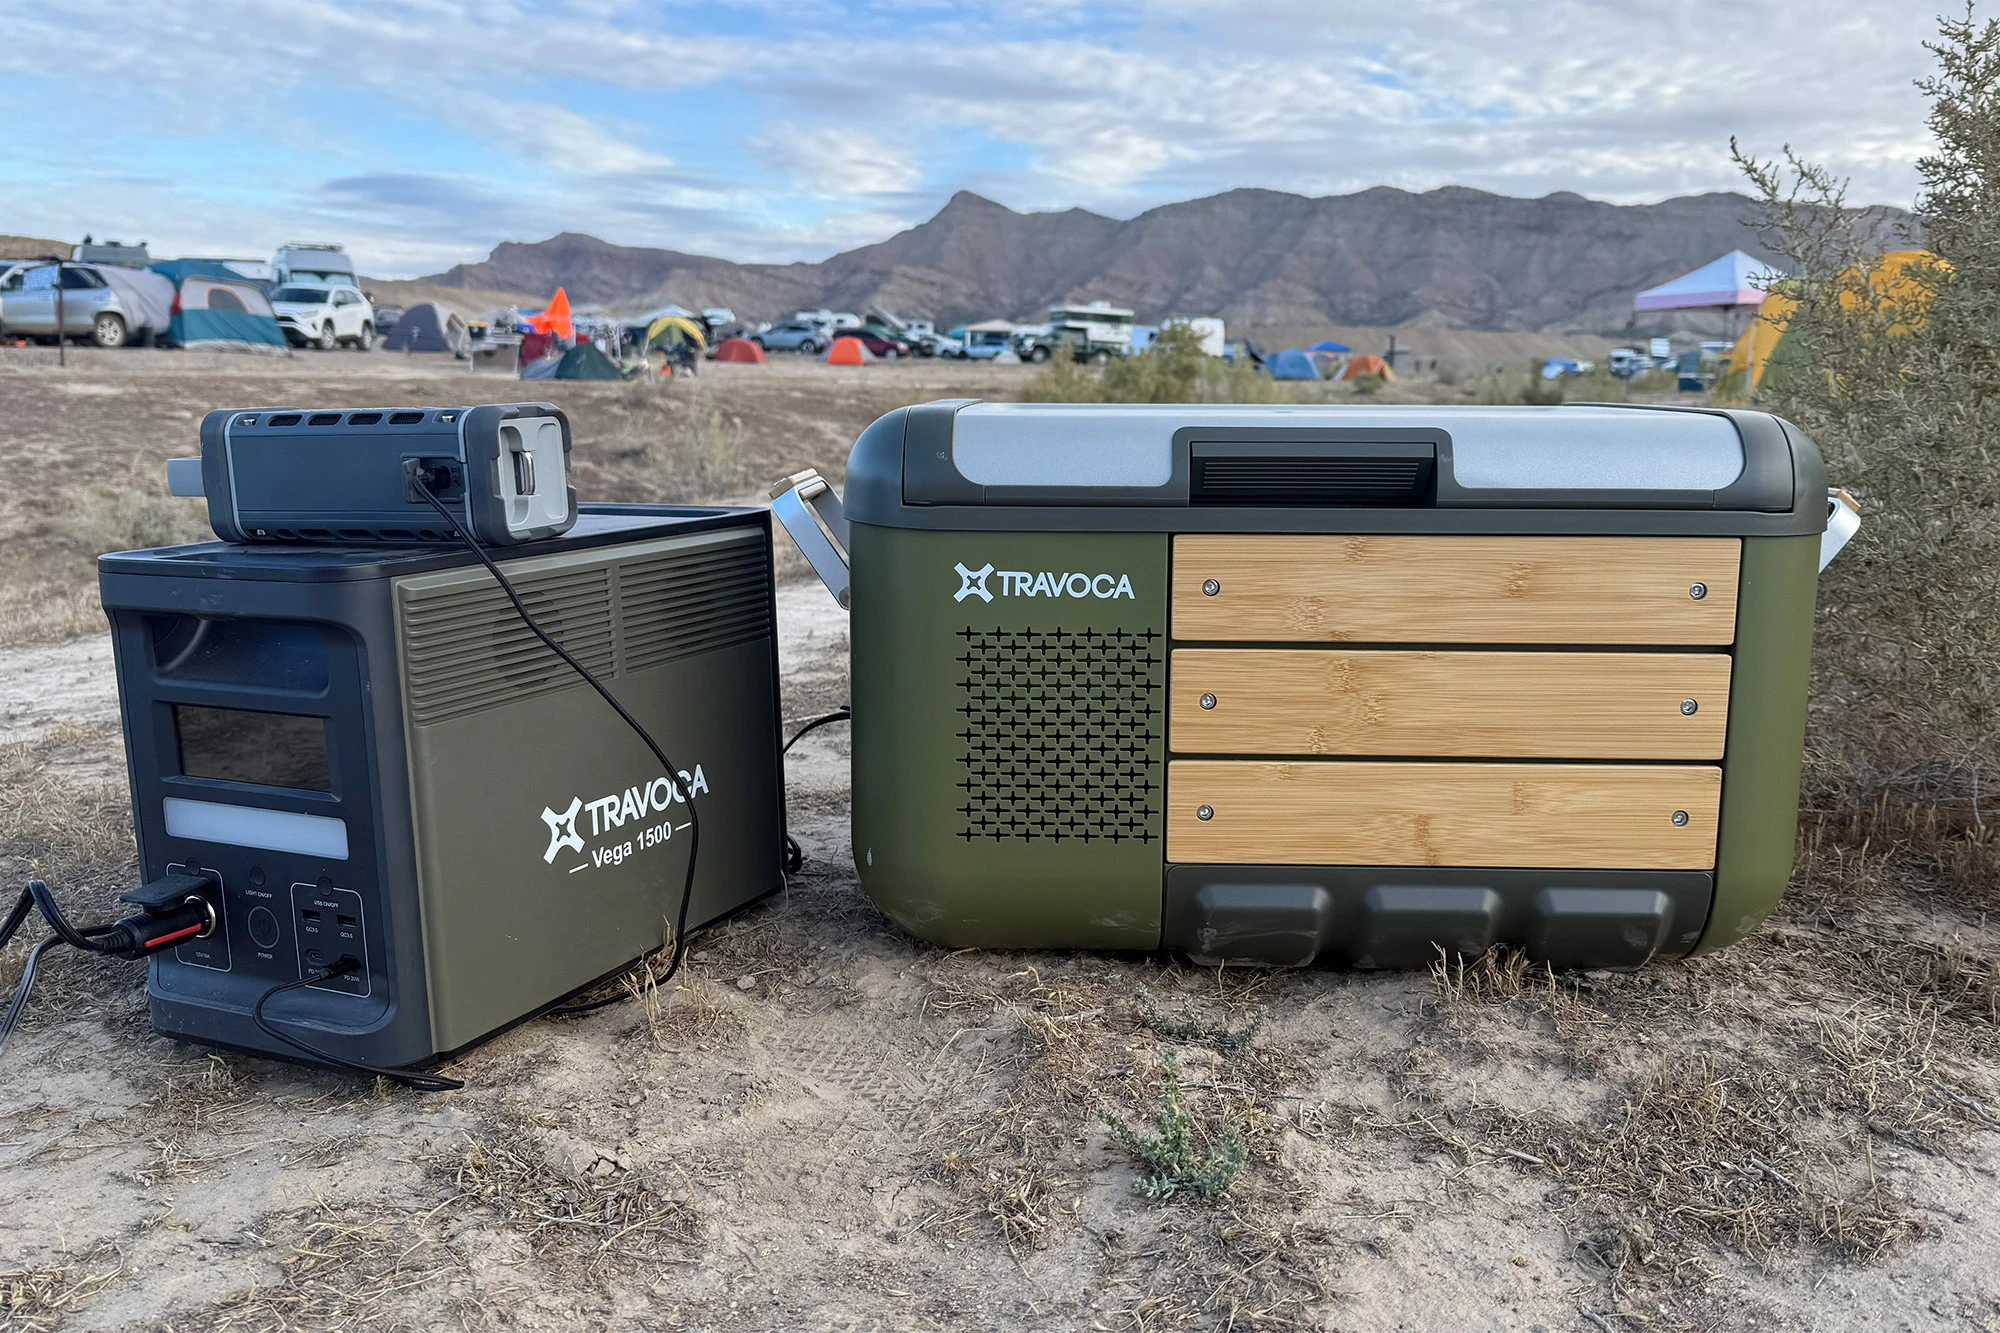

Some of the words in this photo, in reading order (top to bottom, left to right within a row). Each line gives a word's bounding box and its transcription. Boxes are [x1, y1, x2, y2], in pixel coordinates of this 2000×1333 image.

[996, 570, 1136, 600] TRAVOCA
[584, 763, 710, 837] TRAVOCA
[591, 840, 633, 868] Vega
[636, 820, 672, 851] 1500
[257, 951, 273, 960] POWER
